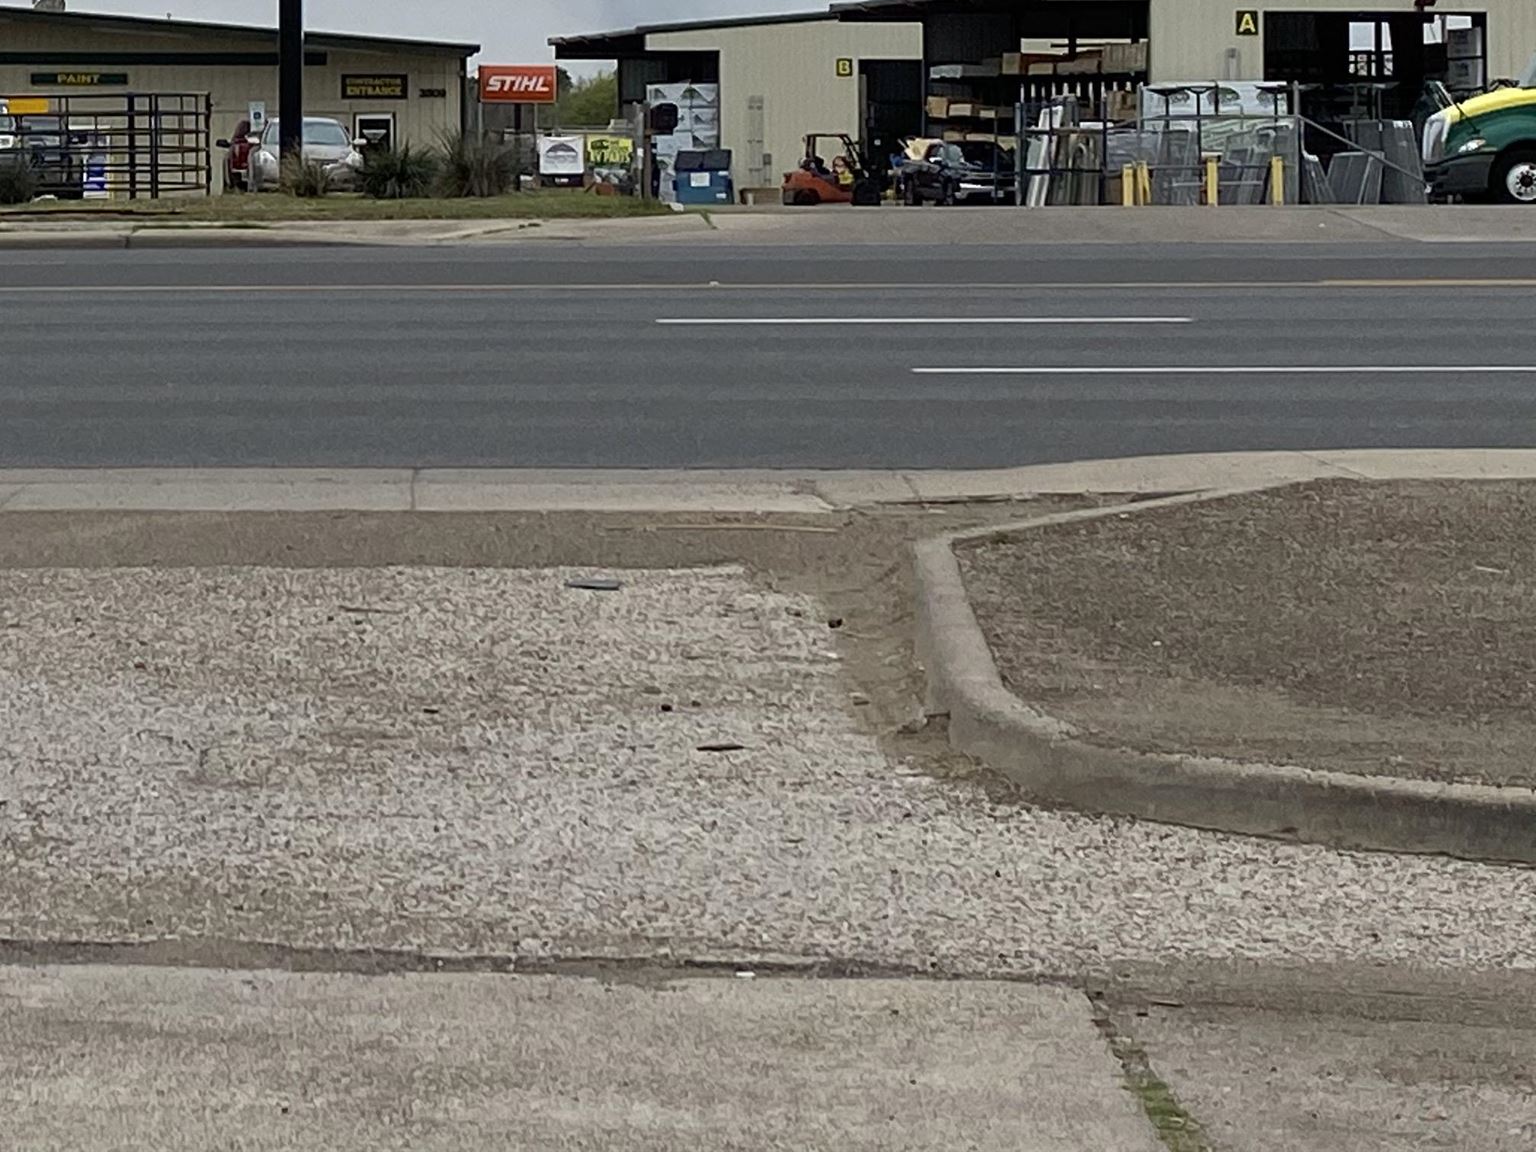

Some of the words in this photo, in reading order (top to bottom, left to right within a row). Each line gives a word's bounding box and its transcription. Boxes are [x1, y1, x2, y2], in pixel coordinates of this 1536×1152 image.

[1239, 13, 1256, 33] A
[838, 60, 850, 74] B
[57, 74, 100, 84] PAINT
[485, 75, 550, 92] STIHL
[346, 86, 402, 96] ENTRANCE
